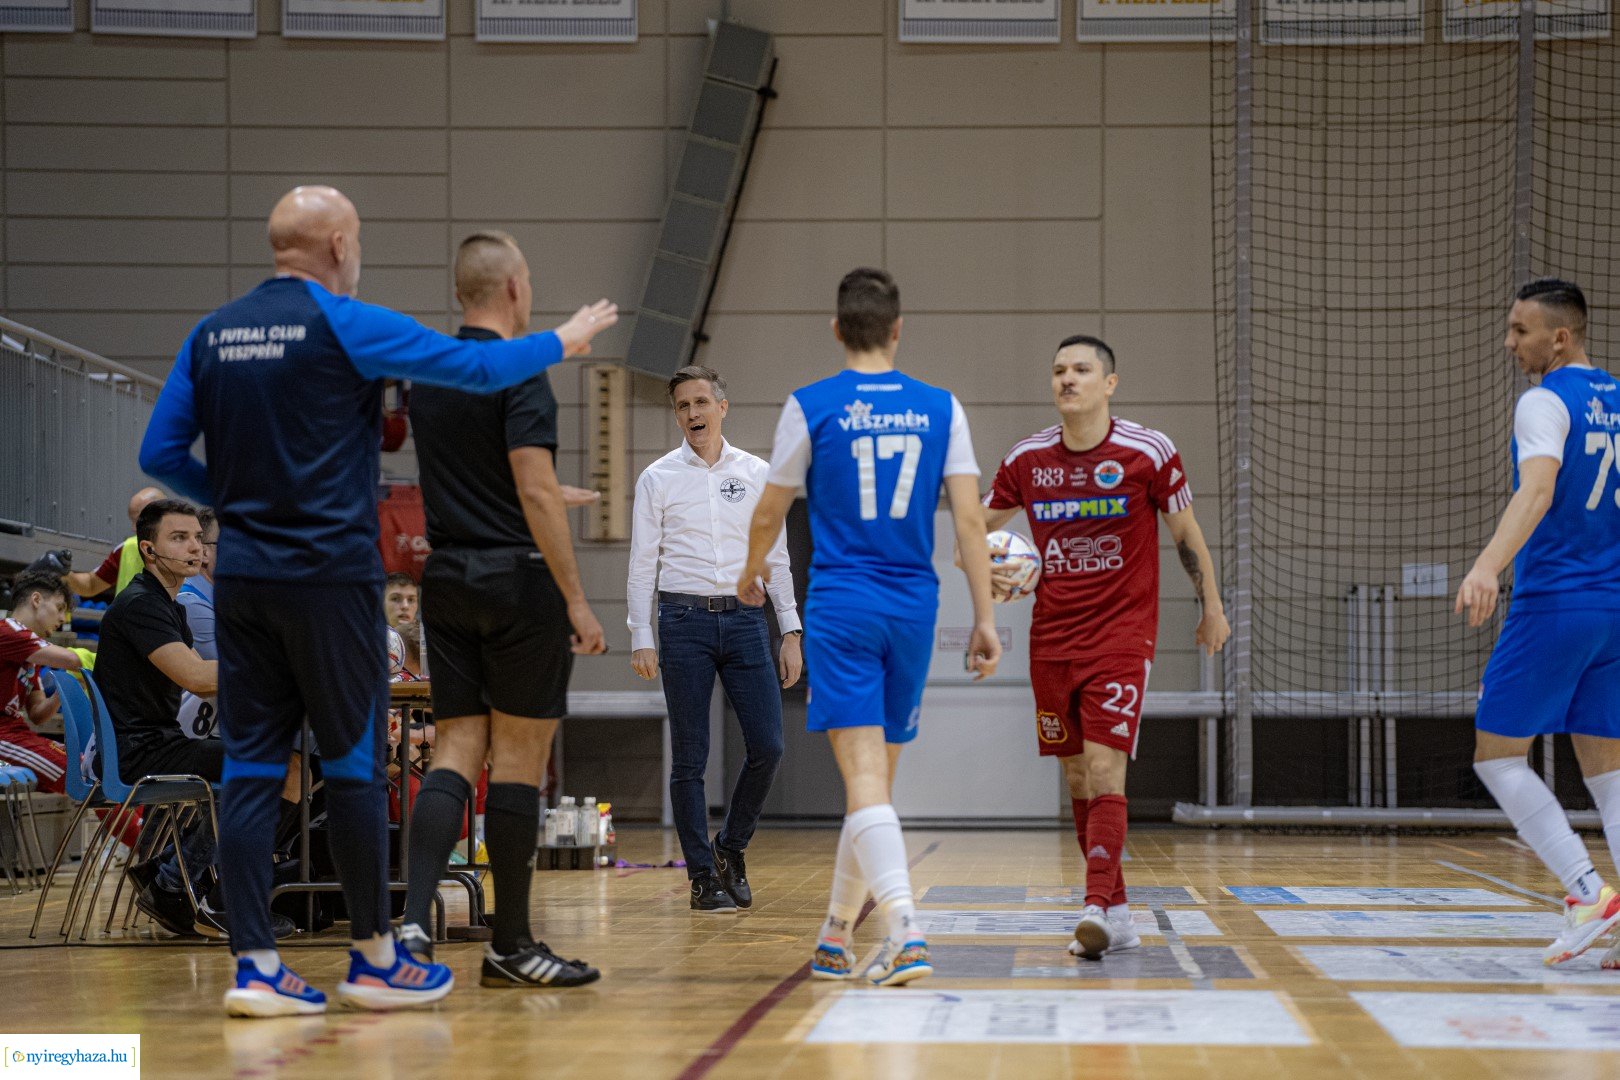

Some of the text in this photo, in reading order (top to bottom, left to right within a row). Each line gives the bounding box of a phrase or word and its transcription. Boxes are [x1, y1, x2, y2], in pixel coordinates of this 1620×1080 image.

[268, 325, 306, 341] CLUB
[851, 434, 922, 520] 17
[1031, 467, 1064, 487] 383
[1585, 431, 1620, 510] 7
[1045, 556, 1124, 574] STUDIO
[1101, 682, 1138, 717] 22
